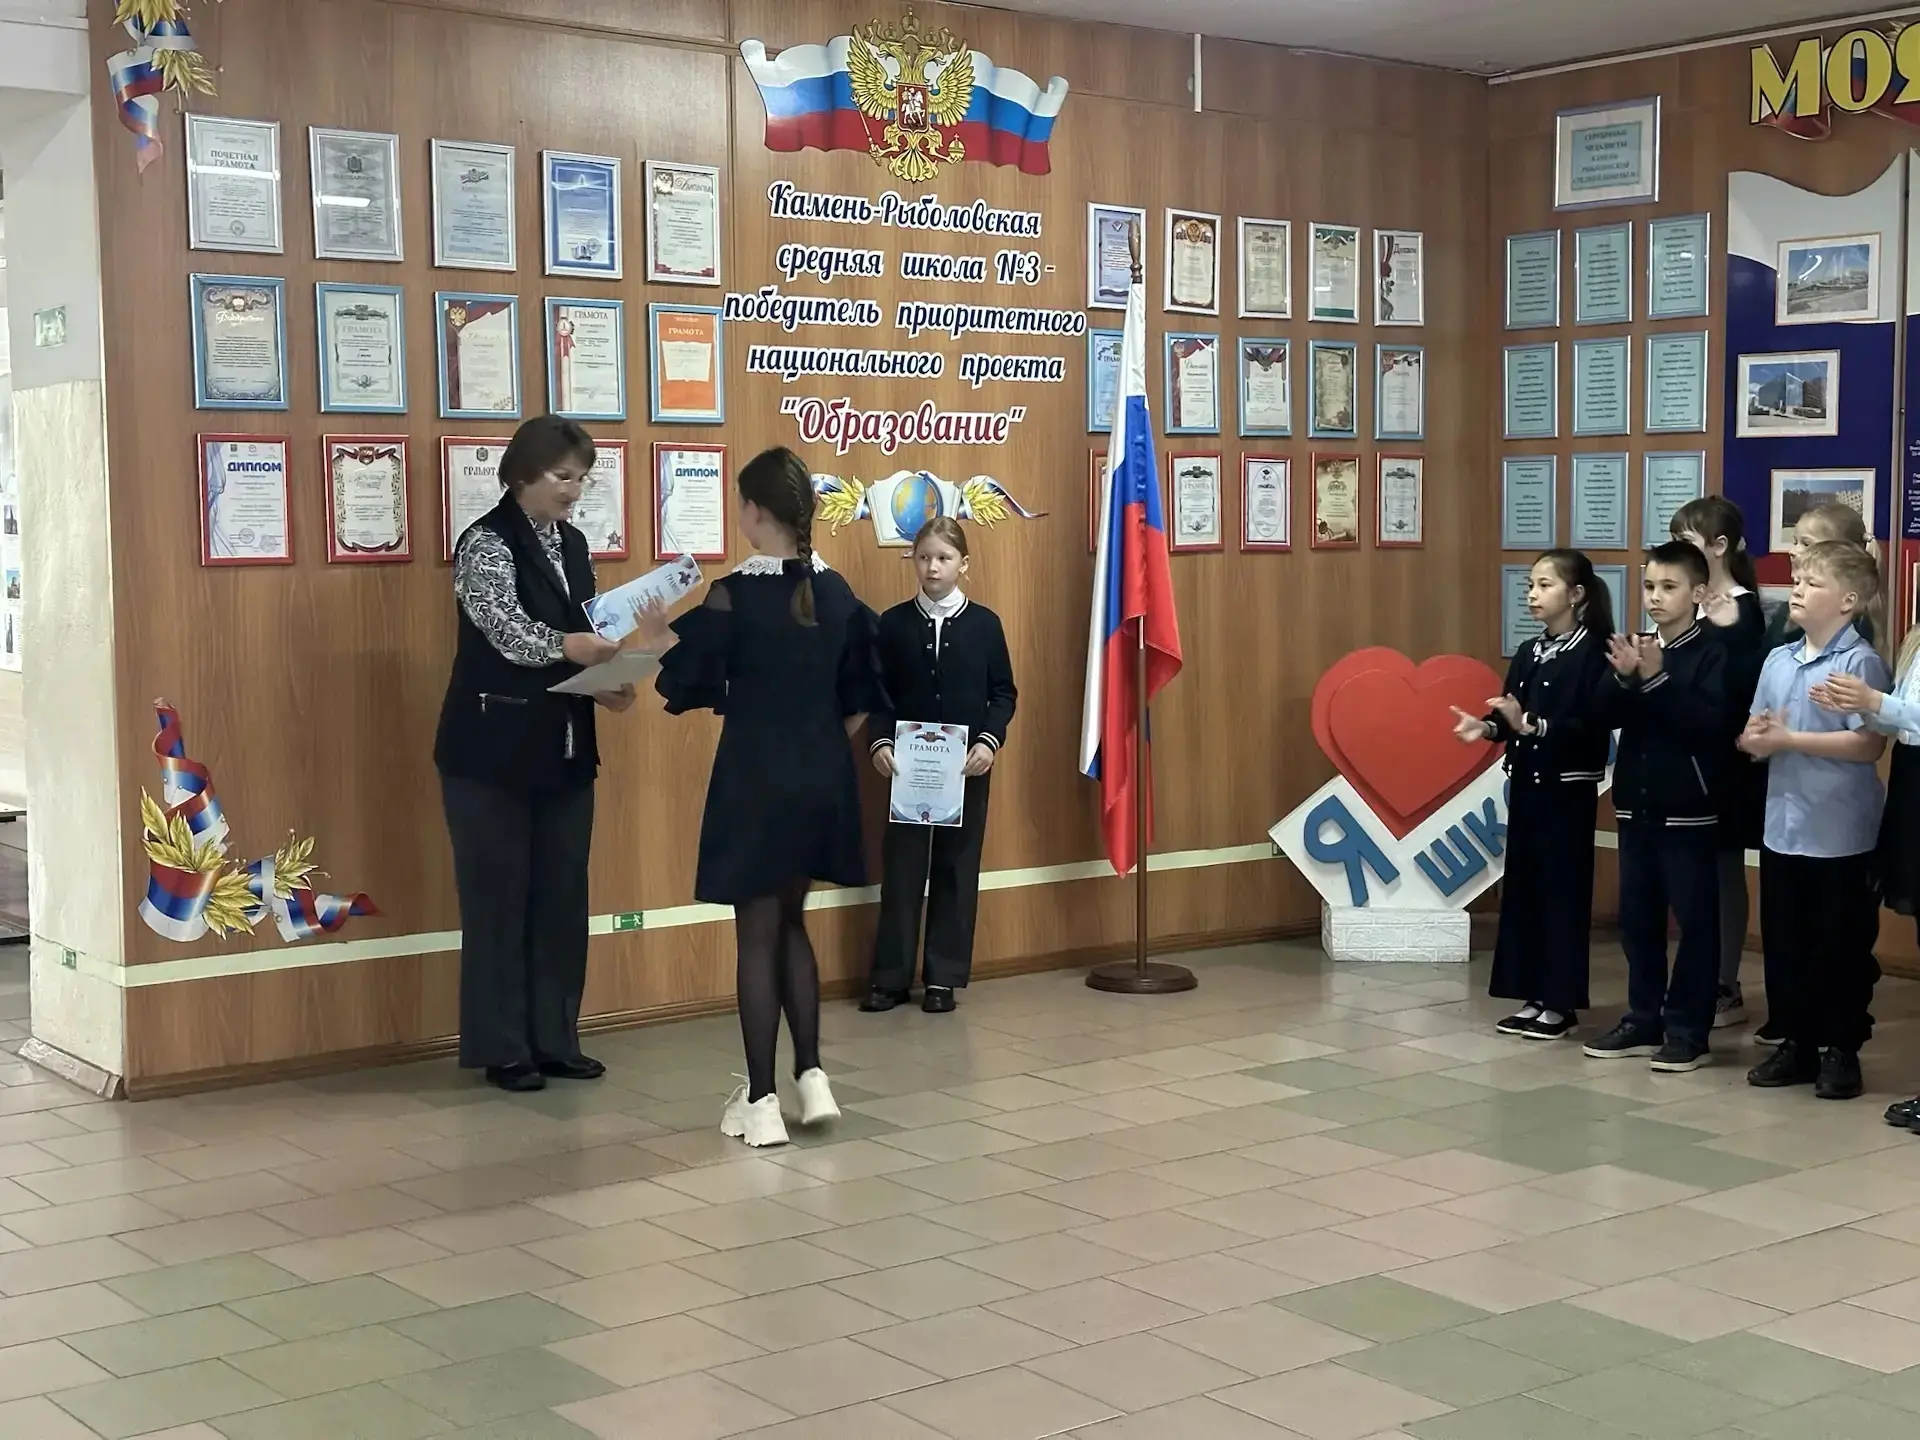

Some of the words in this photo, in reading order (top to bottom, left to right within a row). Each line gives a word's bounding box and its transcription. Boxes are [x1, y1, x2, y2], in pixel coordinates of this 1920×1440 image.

[210, 150, 259, 161] ПОЧЕТНАЯ
[214, 160, 256, 170] ГРАМОТА
[770, 183, 1040, 234] Камень-Рыболовская
[778, 245, 883, 280] средняя
[902, 254, 985, 281] школа
[574, 310, 613, 320] ГРАМОТА
[723, 286, 881, 331] победитель
[898, 303, 1086, 337] приоритетного
[668, 327, 705, 336] ГРАМОТА
[748, 346, 943, 381] национального
[960, 354, 1065, 388] проекта
[781, 398, 1026, 453] "Образование"
[227, 461, 282, 472] ДИПЛОМ
[675, 467, 719, 477] ДИПЛОМ
[909, 743, 951, 753] ГРАМОТА
[1304, 794, 1400, 907] Я
